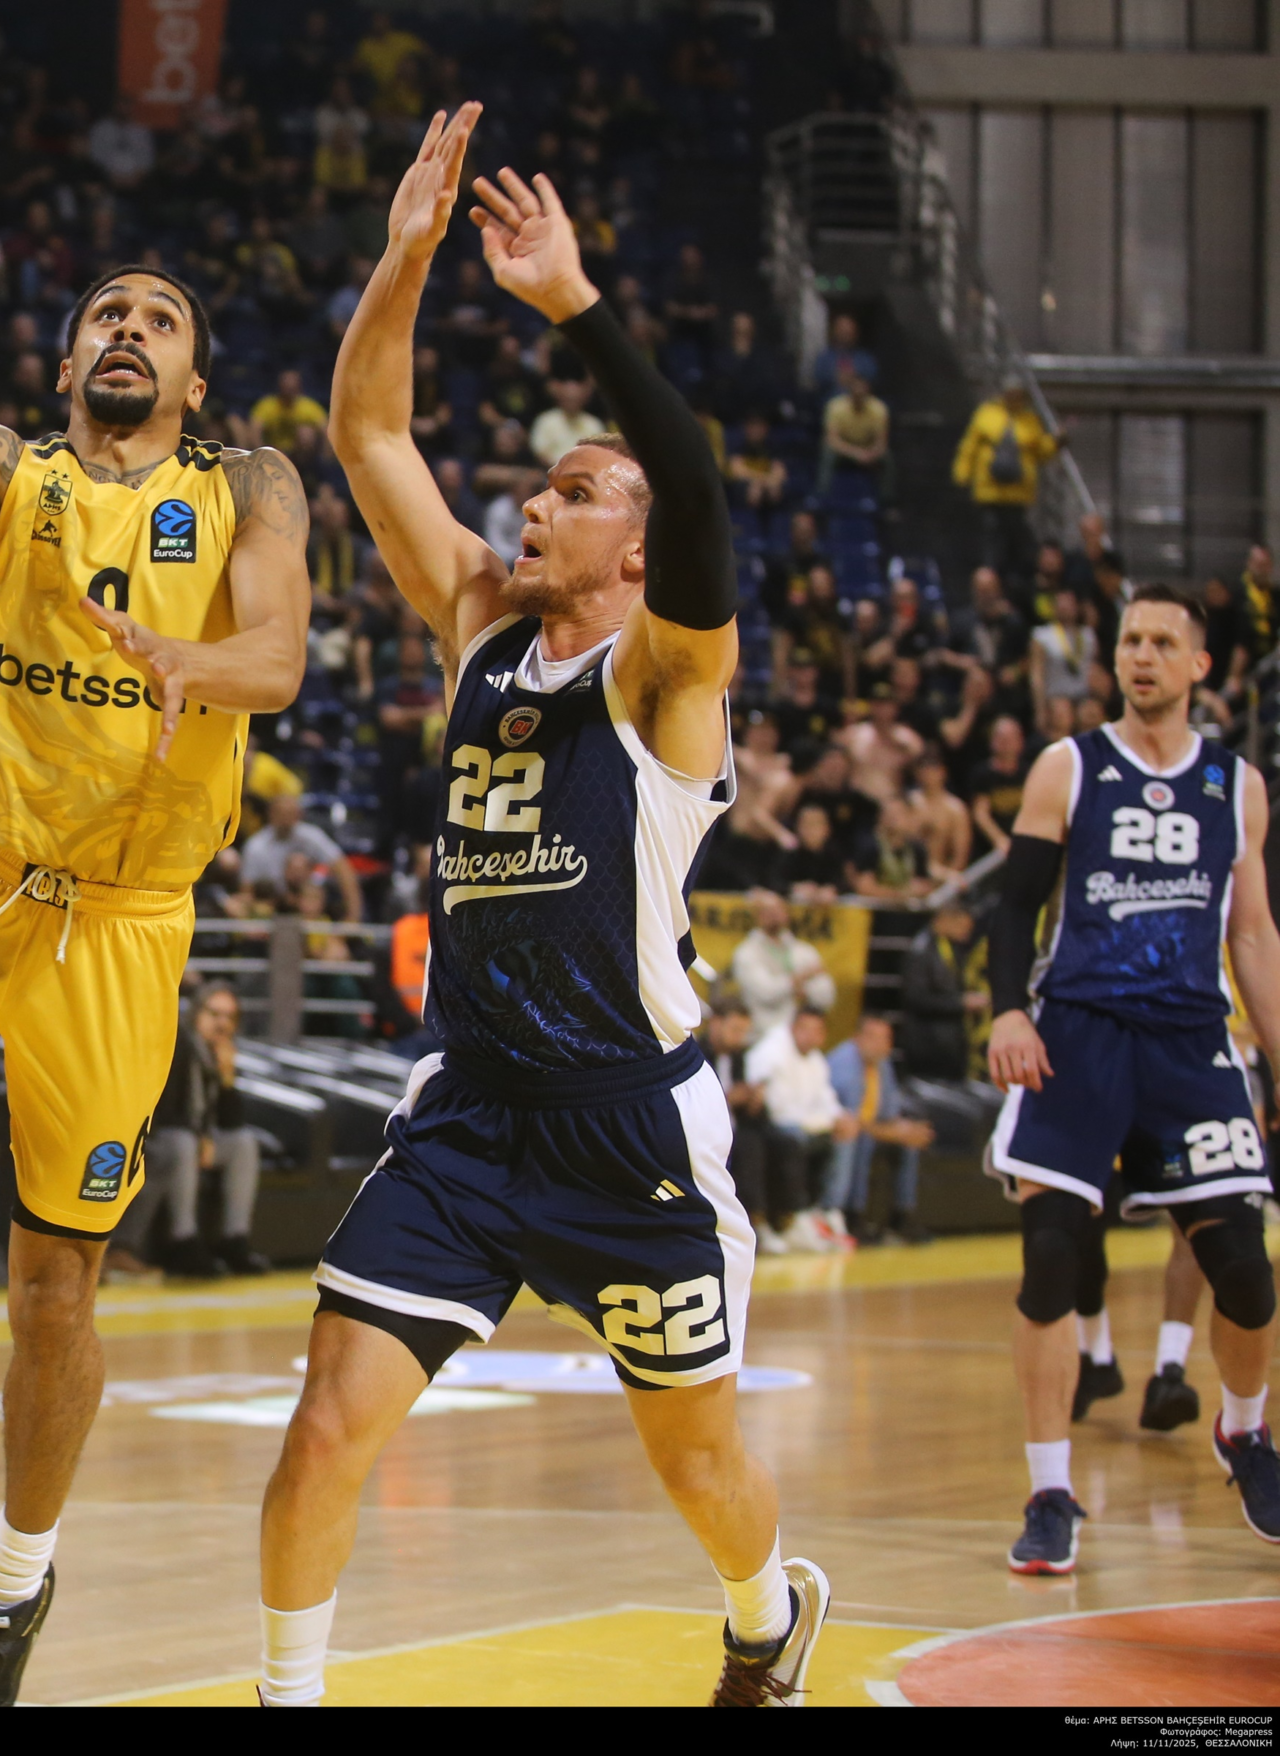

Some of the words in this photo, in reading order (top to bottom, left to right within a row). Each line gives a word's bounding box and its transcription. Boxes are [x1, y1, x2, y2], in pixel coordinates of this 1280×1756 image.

[153, 548, 193, 559] EuroCup
[158, 538, 188, 548] BKT
[446, 743, 546, 833] 22
[1110, 806, 1200, 864] 28
[1184, 1117, 1265, 1176] 28
[82, 1188, 118, 1198] EuroCup
[89, 1179, 117, 1188] BKT
[597, 1274, 726, 1356] 22
